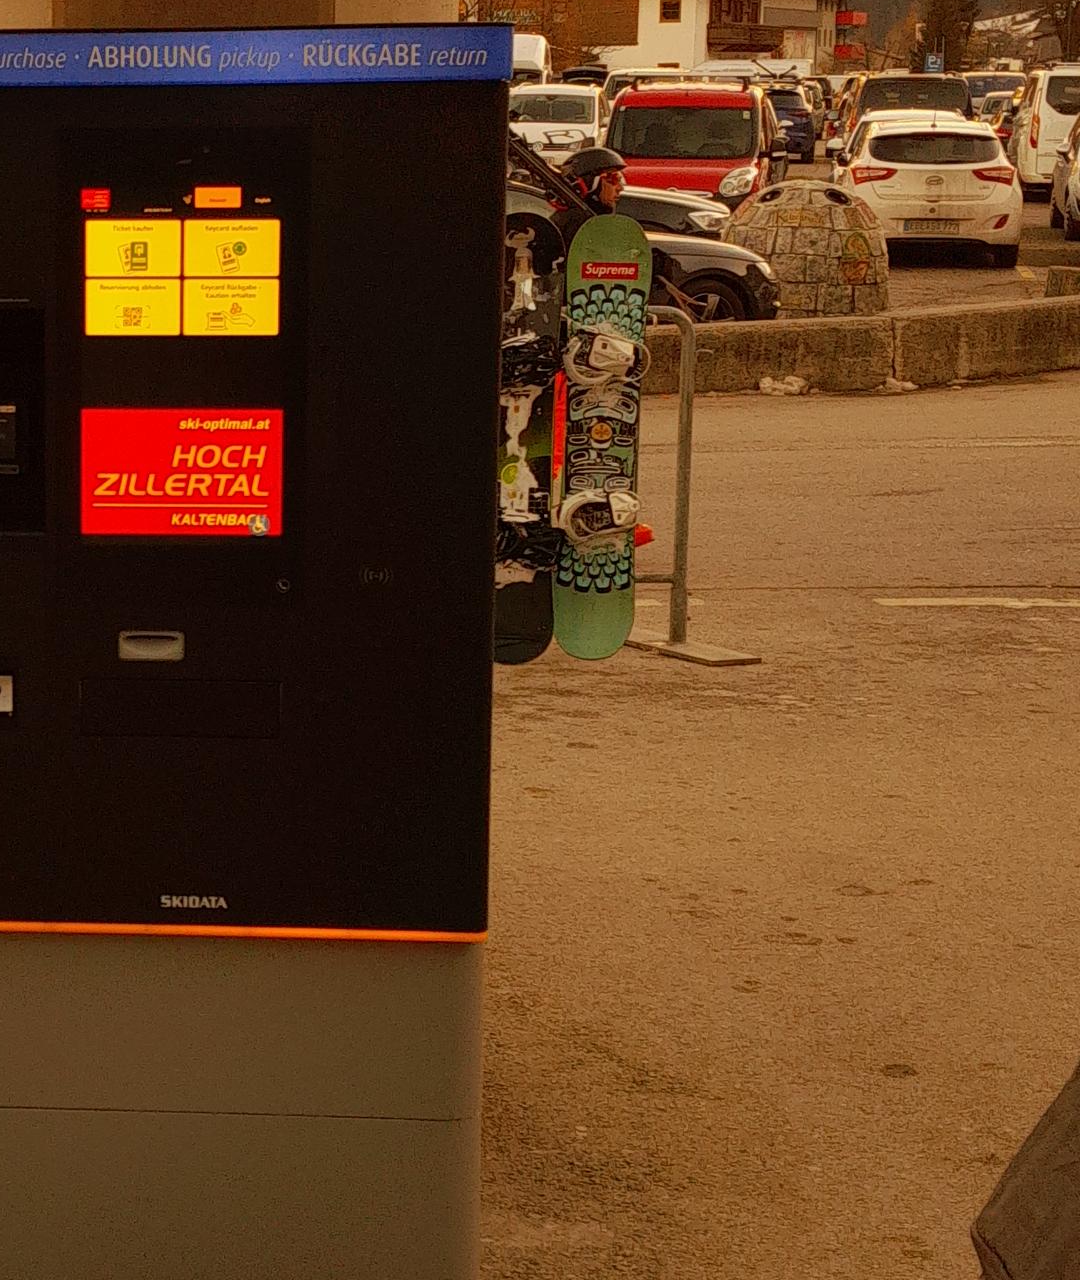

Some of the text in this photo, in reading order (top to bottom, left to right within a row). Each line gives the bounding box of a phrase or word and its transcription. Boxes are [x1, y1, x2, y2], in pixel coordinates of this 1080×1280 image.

[88, 44, 212, 68] ABHOLUNG
[219, 45, 281, 72] pickup
[303, 40, 422, 67] RÜCKGABE
[428, 46, 488, 67] return
[585, 263, 635, 277] Supreme
[179, 418, 270, 432] ski-optimal.at
[172, 445, 267, 468] HOCH
[94, 473, 269, 497] ZILLERTAL
[160, 895, 228, 908] SKIDATA
